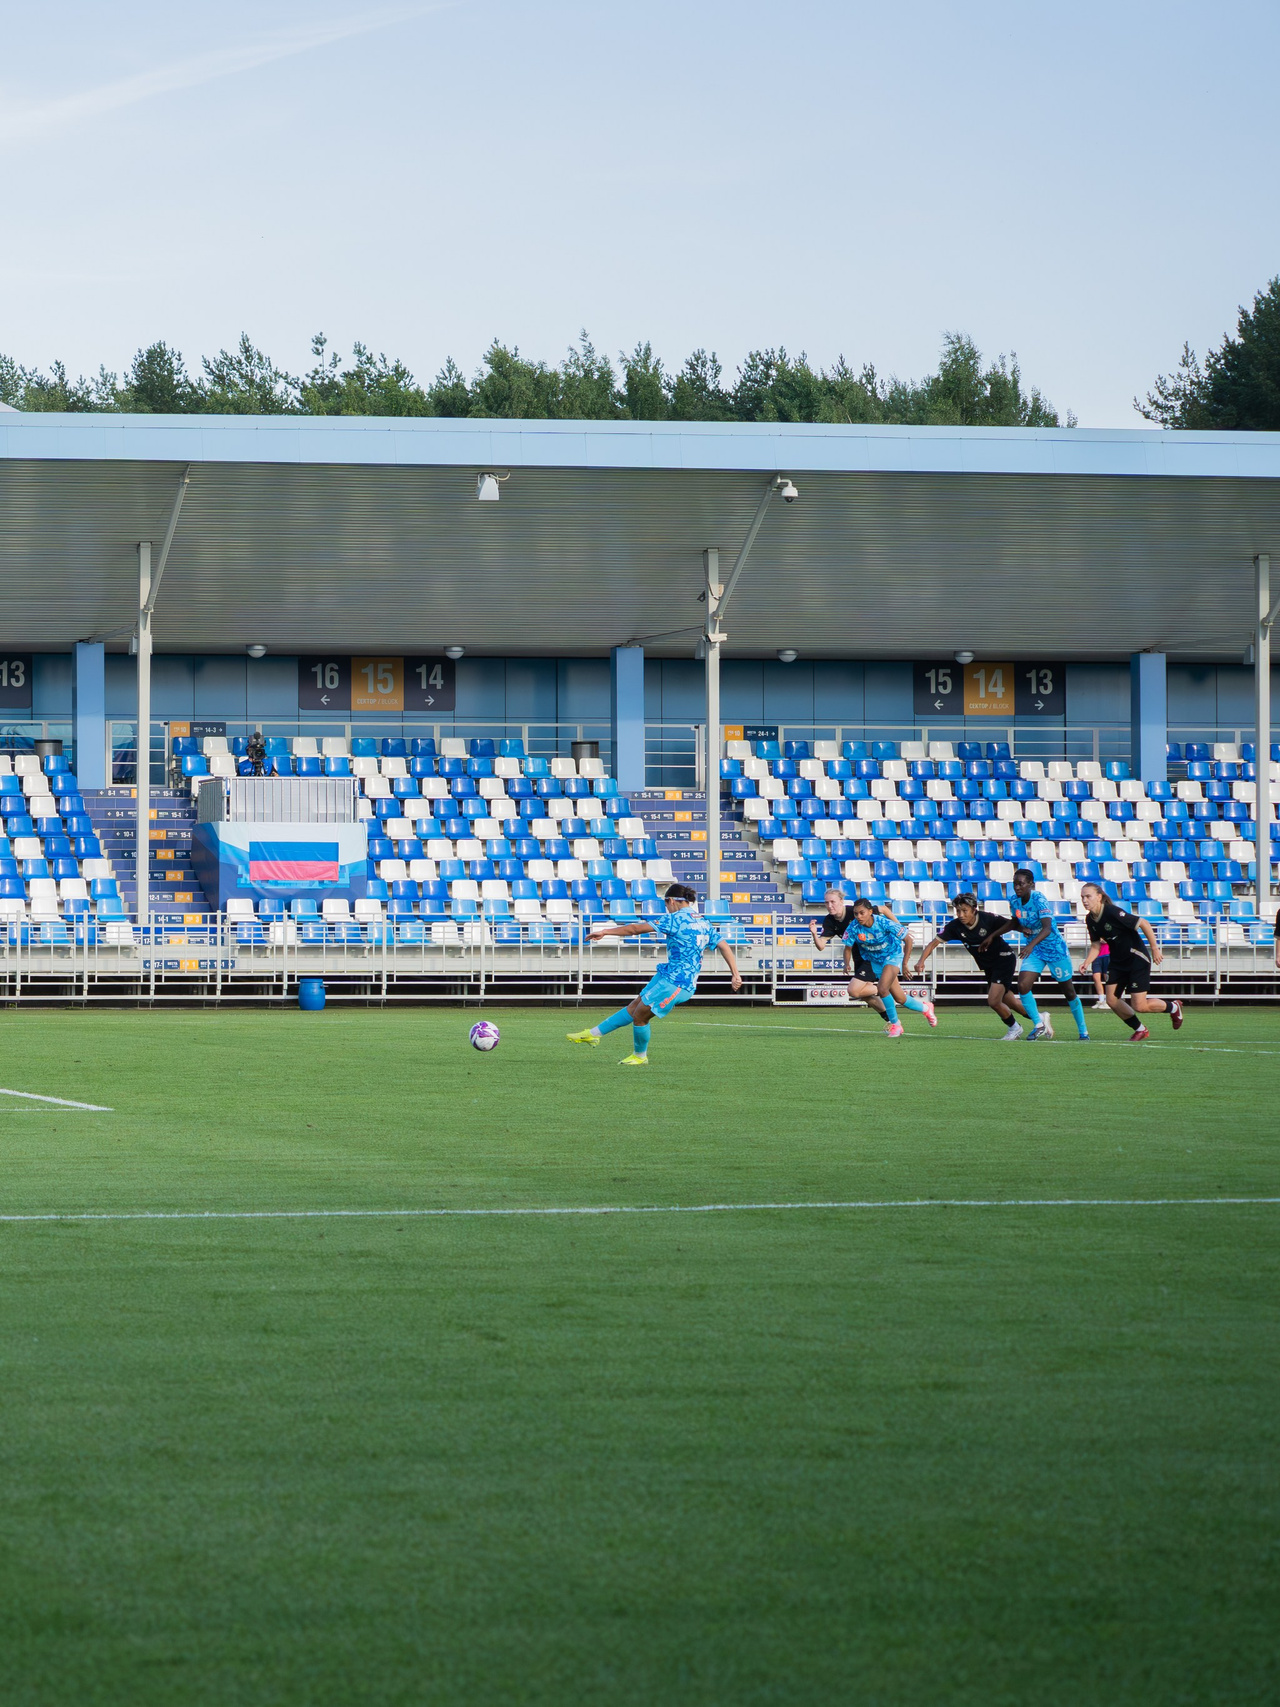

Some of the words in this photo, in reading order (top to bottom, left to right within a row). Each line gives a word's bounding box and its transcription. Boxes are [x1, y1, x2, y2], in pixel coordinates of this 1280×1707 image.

[311, 663, 339, 689] 16
[361, 663, 394, 694] 15
[415, 663, 444, 690] 14
[925, 668, 953, 694] 15
[972, 668, 1006, 699] 14
[1025, 669, 1053, 695] 13
[992, 702, 1010, 710] BLOCK
[1054, 966, 1063, 979] 9
